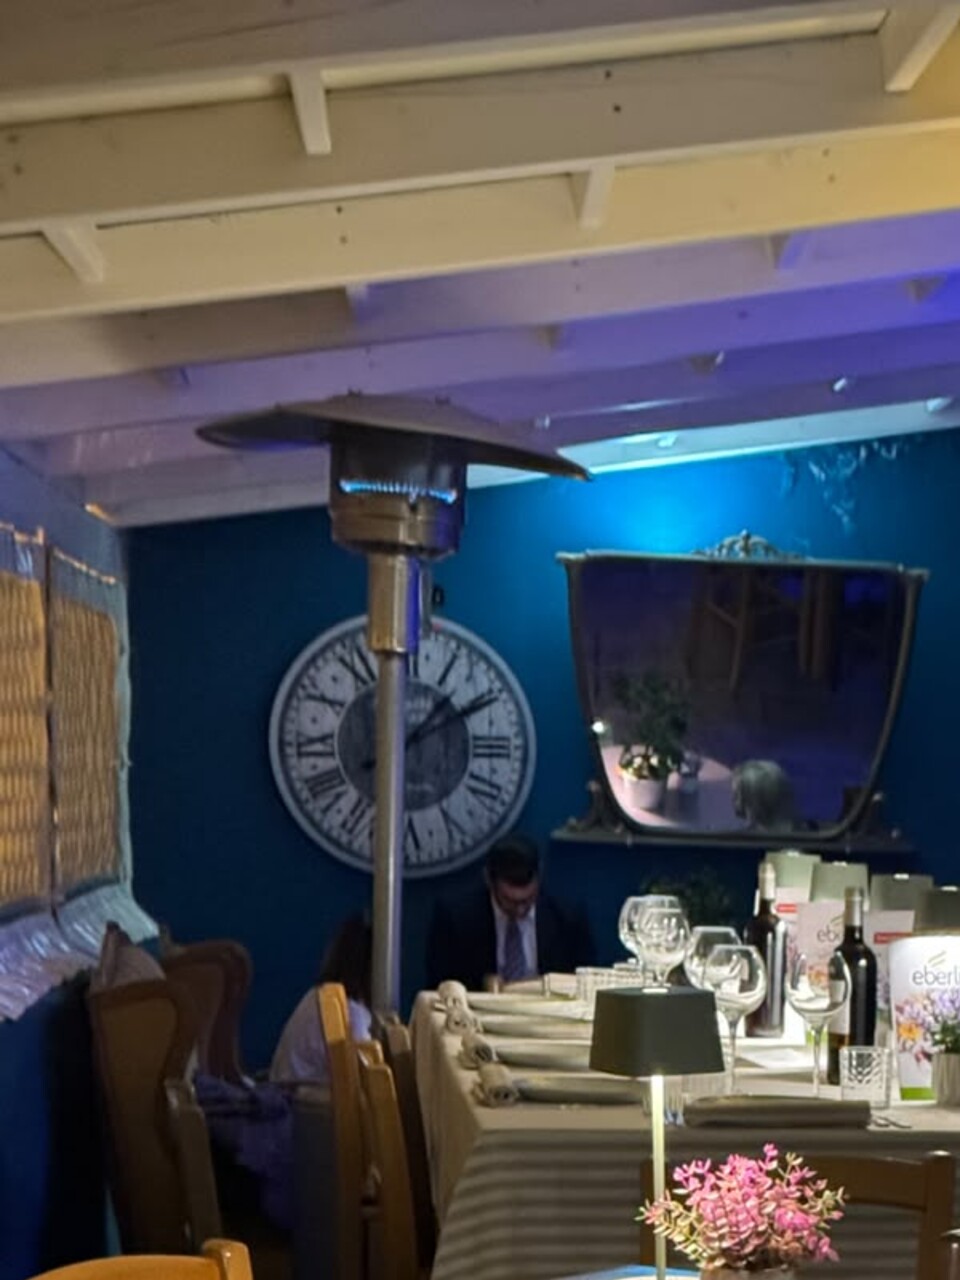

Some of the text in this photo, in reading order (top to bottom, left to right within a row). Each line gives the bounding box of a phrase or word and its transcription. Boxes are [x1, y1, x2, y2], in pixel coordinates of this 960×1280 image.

[338, 644, 378, 691] XI
[297, 732, 336, 757] IX
[472, 734, 511, 759] III
